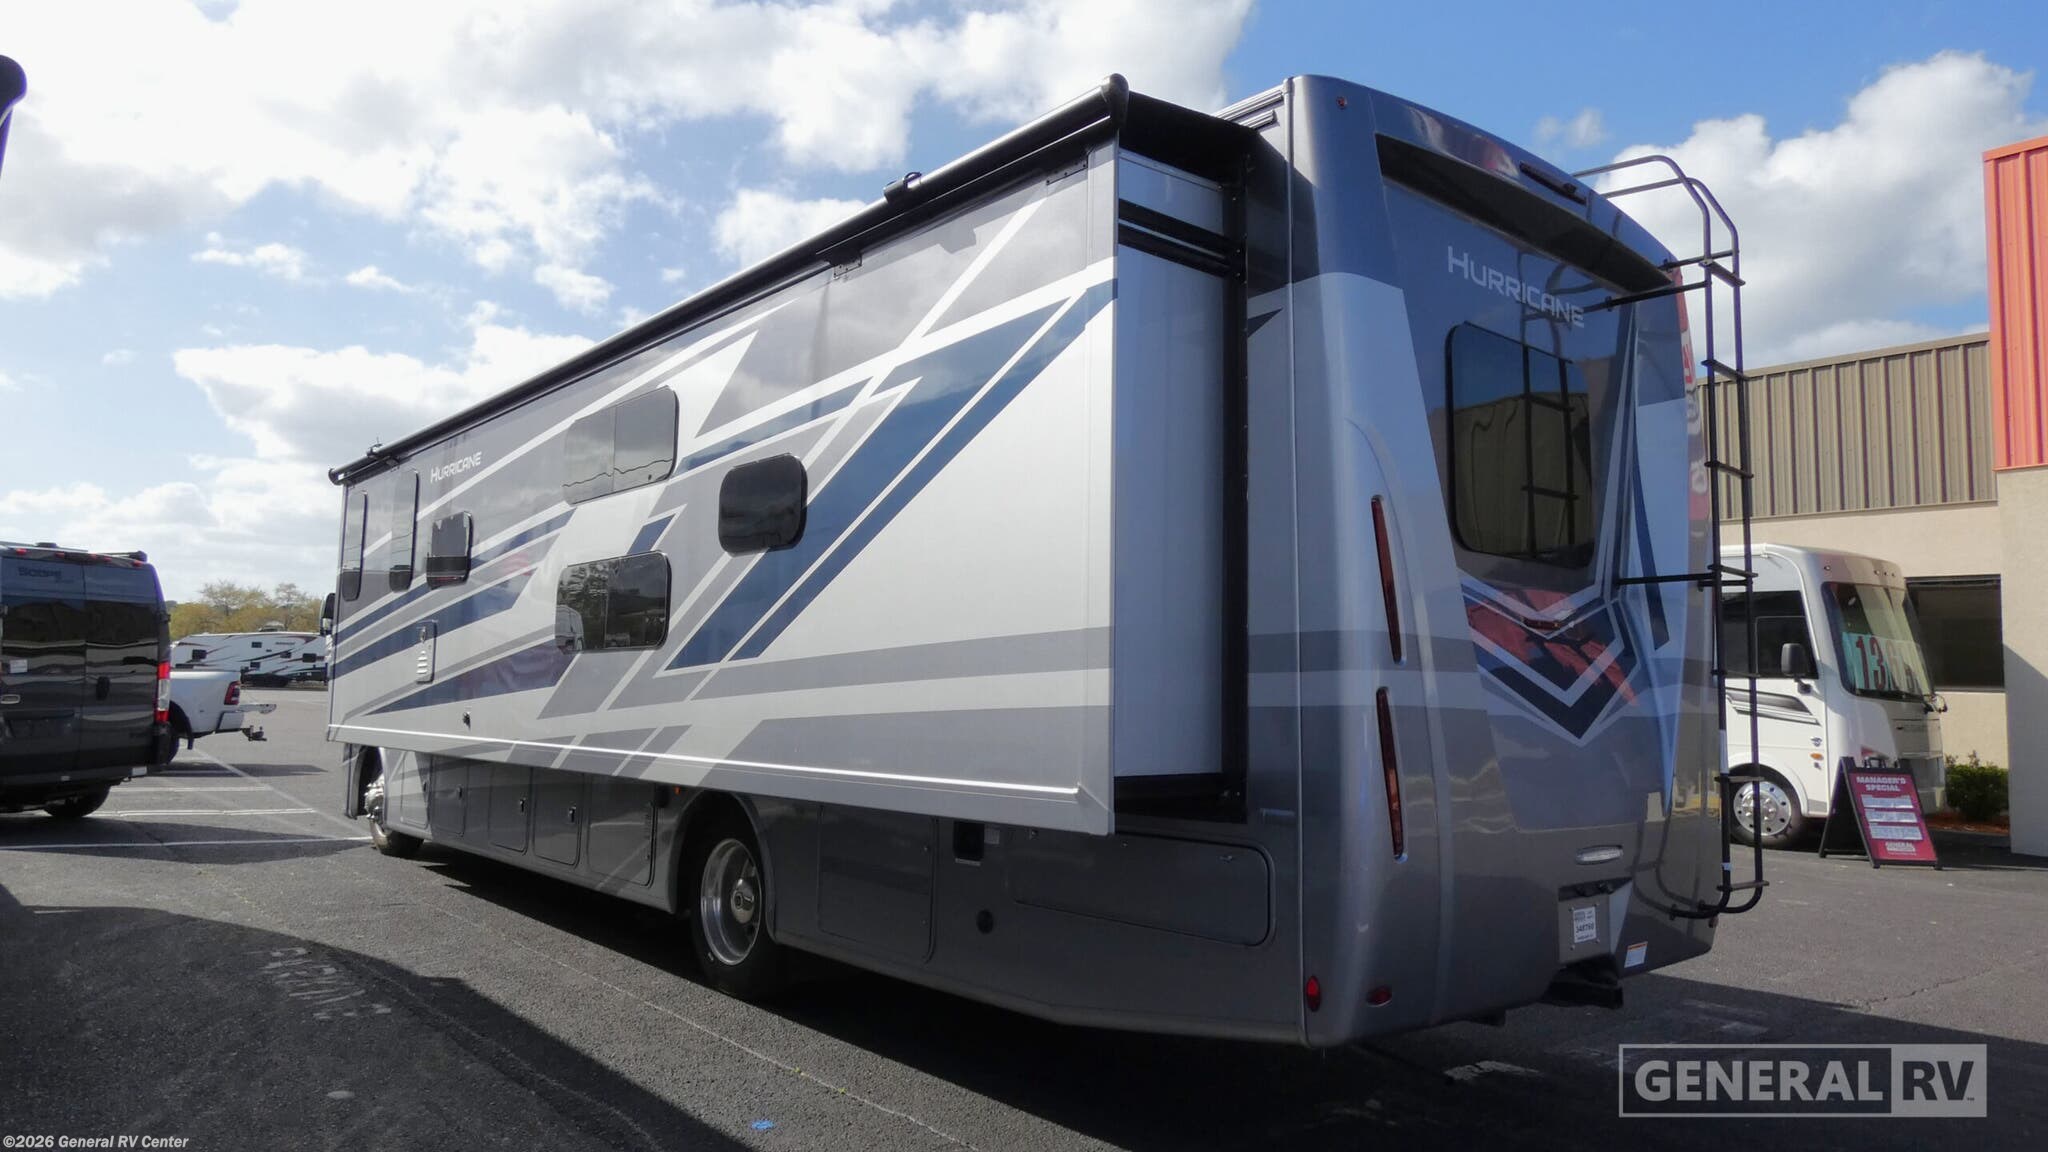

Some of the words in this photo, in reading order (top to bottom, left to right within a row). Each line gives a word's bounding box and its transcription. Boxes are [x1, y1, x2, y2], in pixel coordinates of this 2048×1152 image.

[1447, 245, 1585, 328] HURRICANE
[430, 451, 482, 483] HURRICANE
[1856, 776, 1906, 785] MANAGER'S
[1866, 784, 1900, 792] SPECIAL
